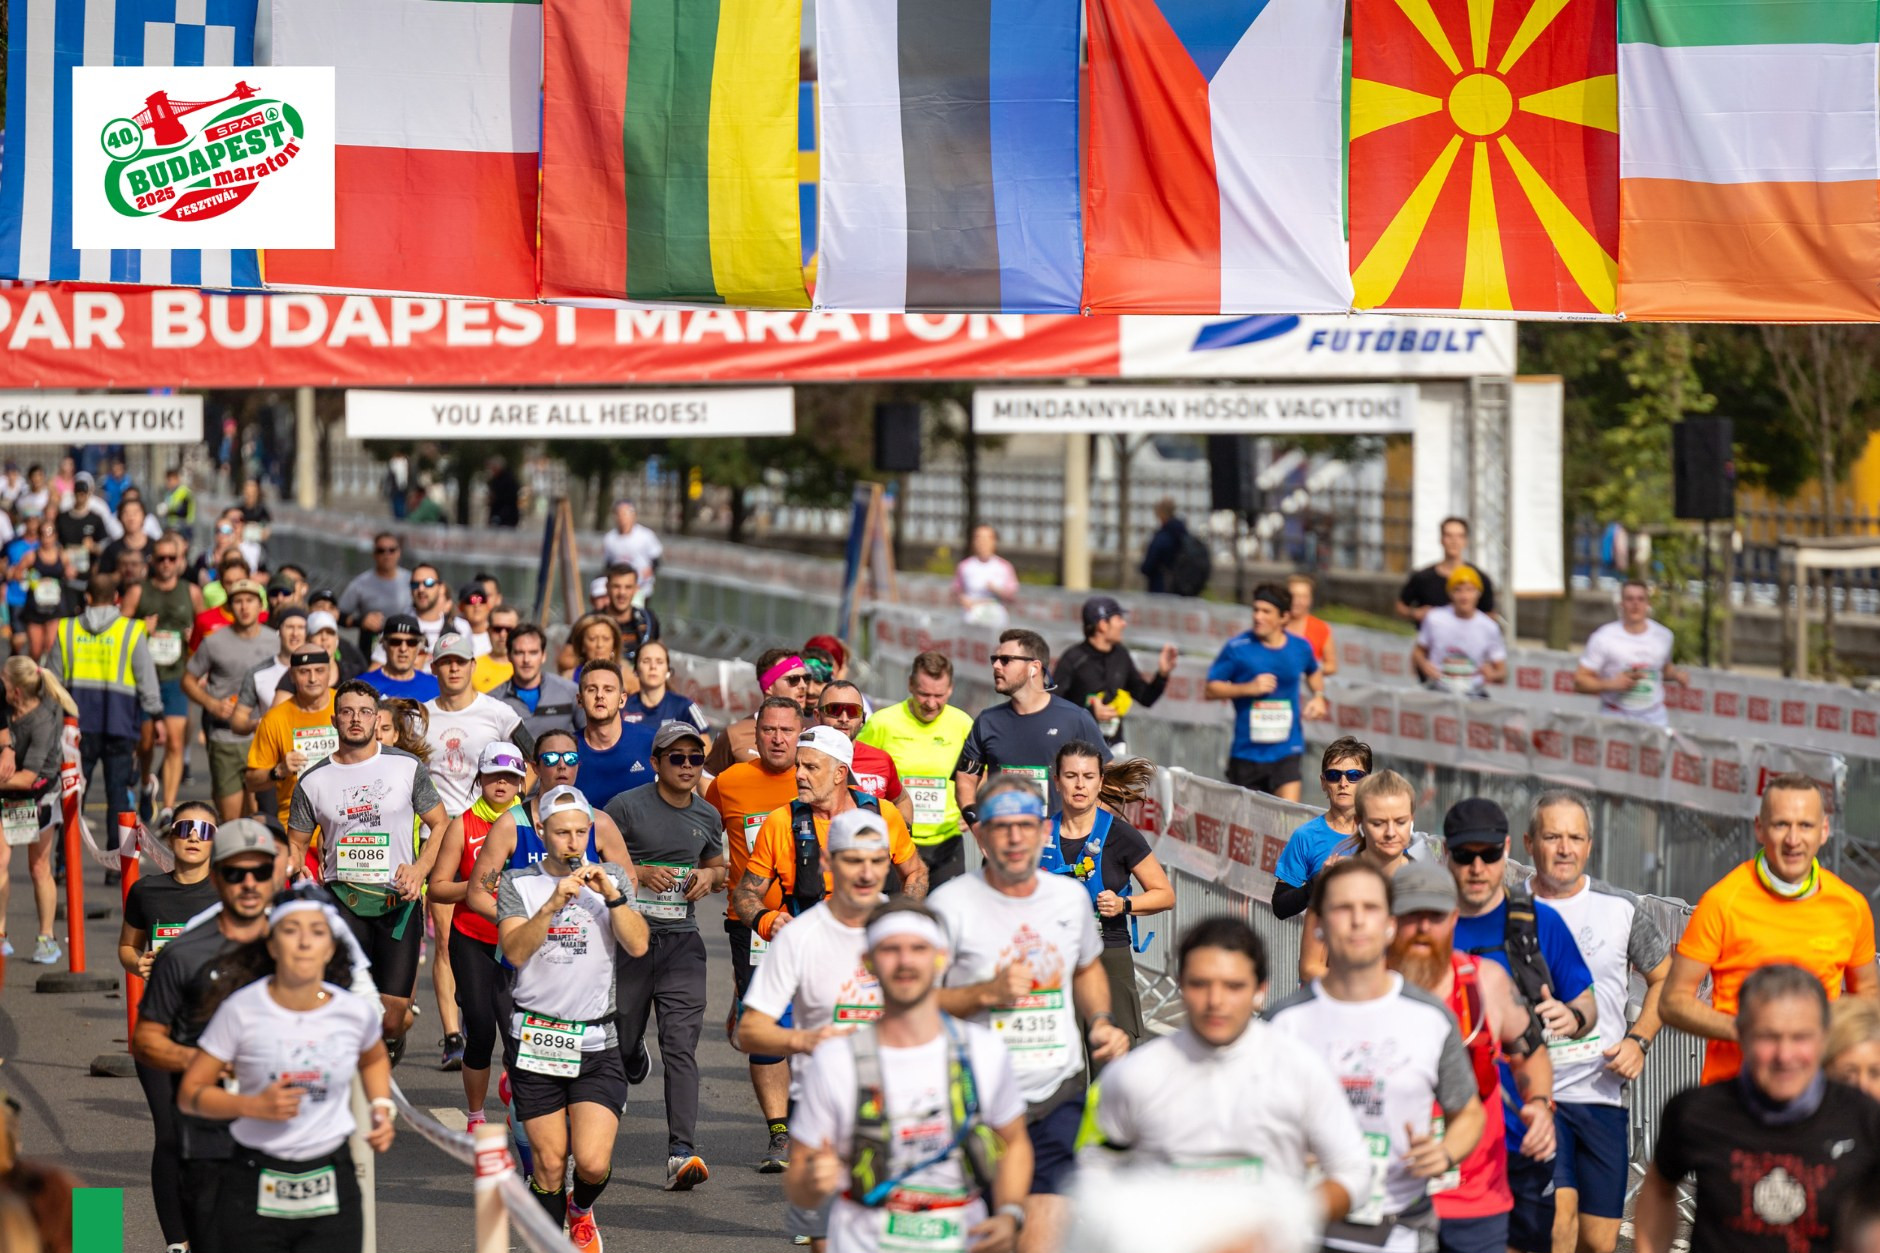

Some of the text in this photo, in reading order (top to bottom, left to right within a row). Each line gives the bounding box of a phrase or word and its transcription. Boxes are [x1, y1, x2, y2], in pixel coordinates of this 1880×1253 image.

[152, 292, 577, 349] BUDAPEST
[432, 402, 708, 425] YOU ARE ALL HEROES!
[992, 400, 1176, 419] MINDANNYIAN
[1277, 400, 1401, 419] VAGYTOK!
[2, 406, 184, 431] SÖK VAGYTOK!
[304, 739, 336, 751] 2499
[915, 790, 938, 801] 626
[346, 836, 376, 844] SPAR
[348, 849, 385, 860] 6086
[534, 1019, 568, 1030] SPAR
[1012, 1014, 1057, 1031] 4315
[533, 1032, 575, 1050] 6898
[276, 1176, 330, 1199] 9434
